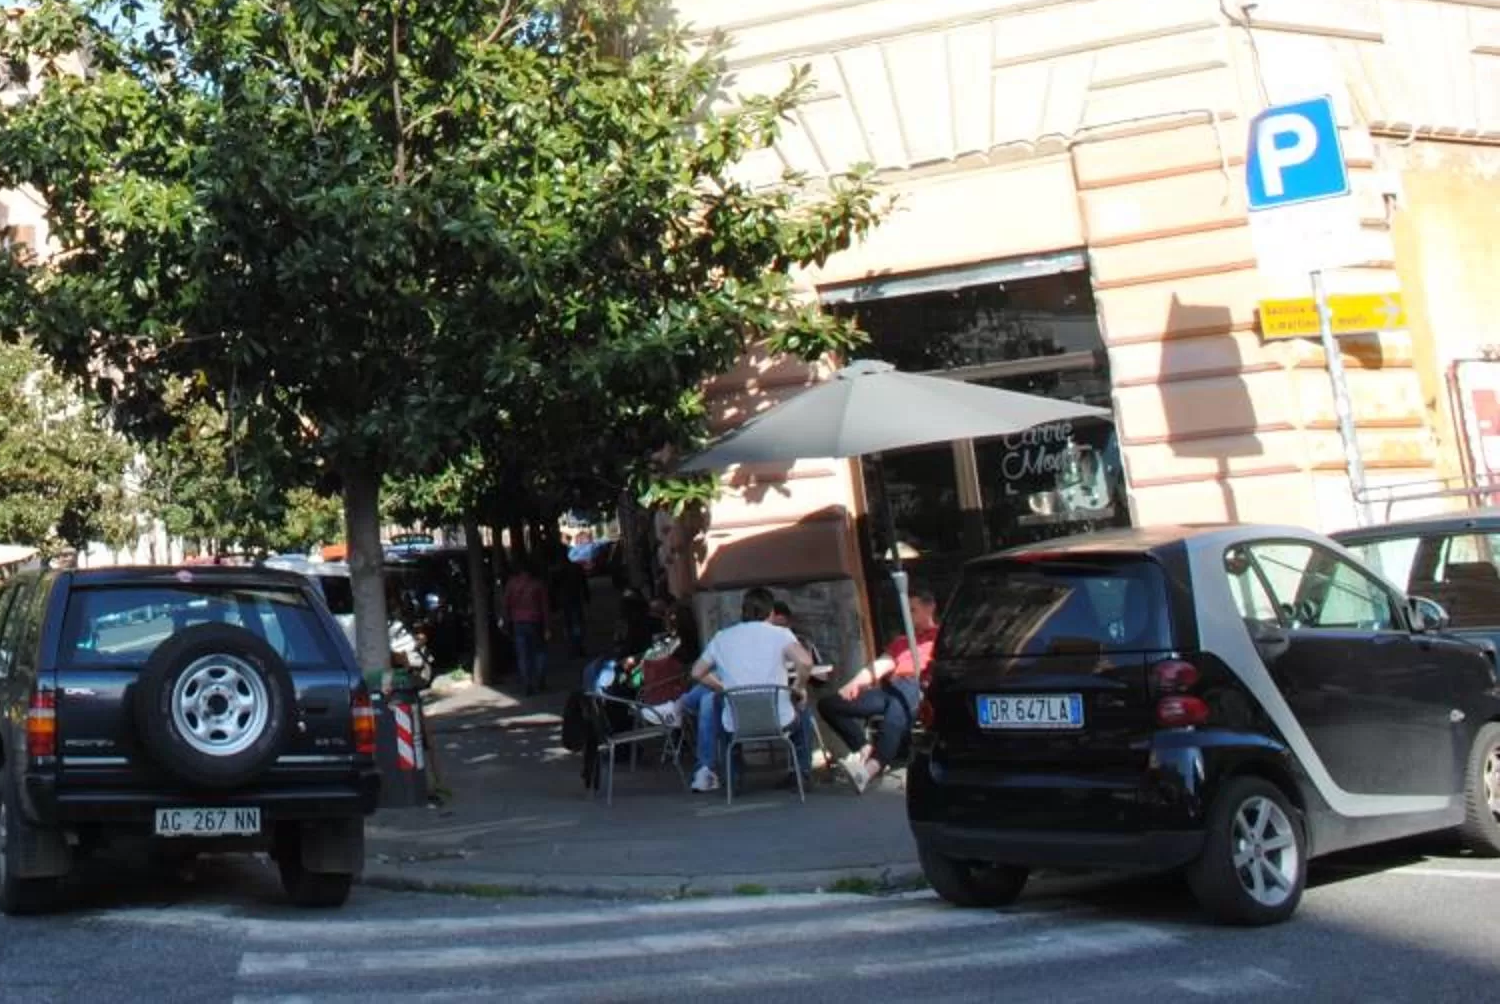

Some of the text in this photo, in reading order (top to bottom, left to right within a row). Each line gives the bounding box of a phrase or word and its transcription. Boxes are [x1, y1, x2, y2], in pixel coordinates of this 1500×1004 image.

[1258, 113, 1318, 196] P
[989, 699, 1010, 721] DR
[160, 810, 257, 831] AC 267 NN
